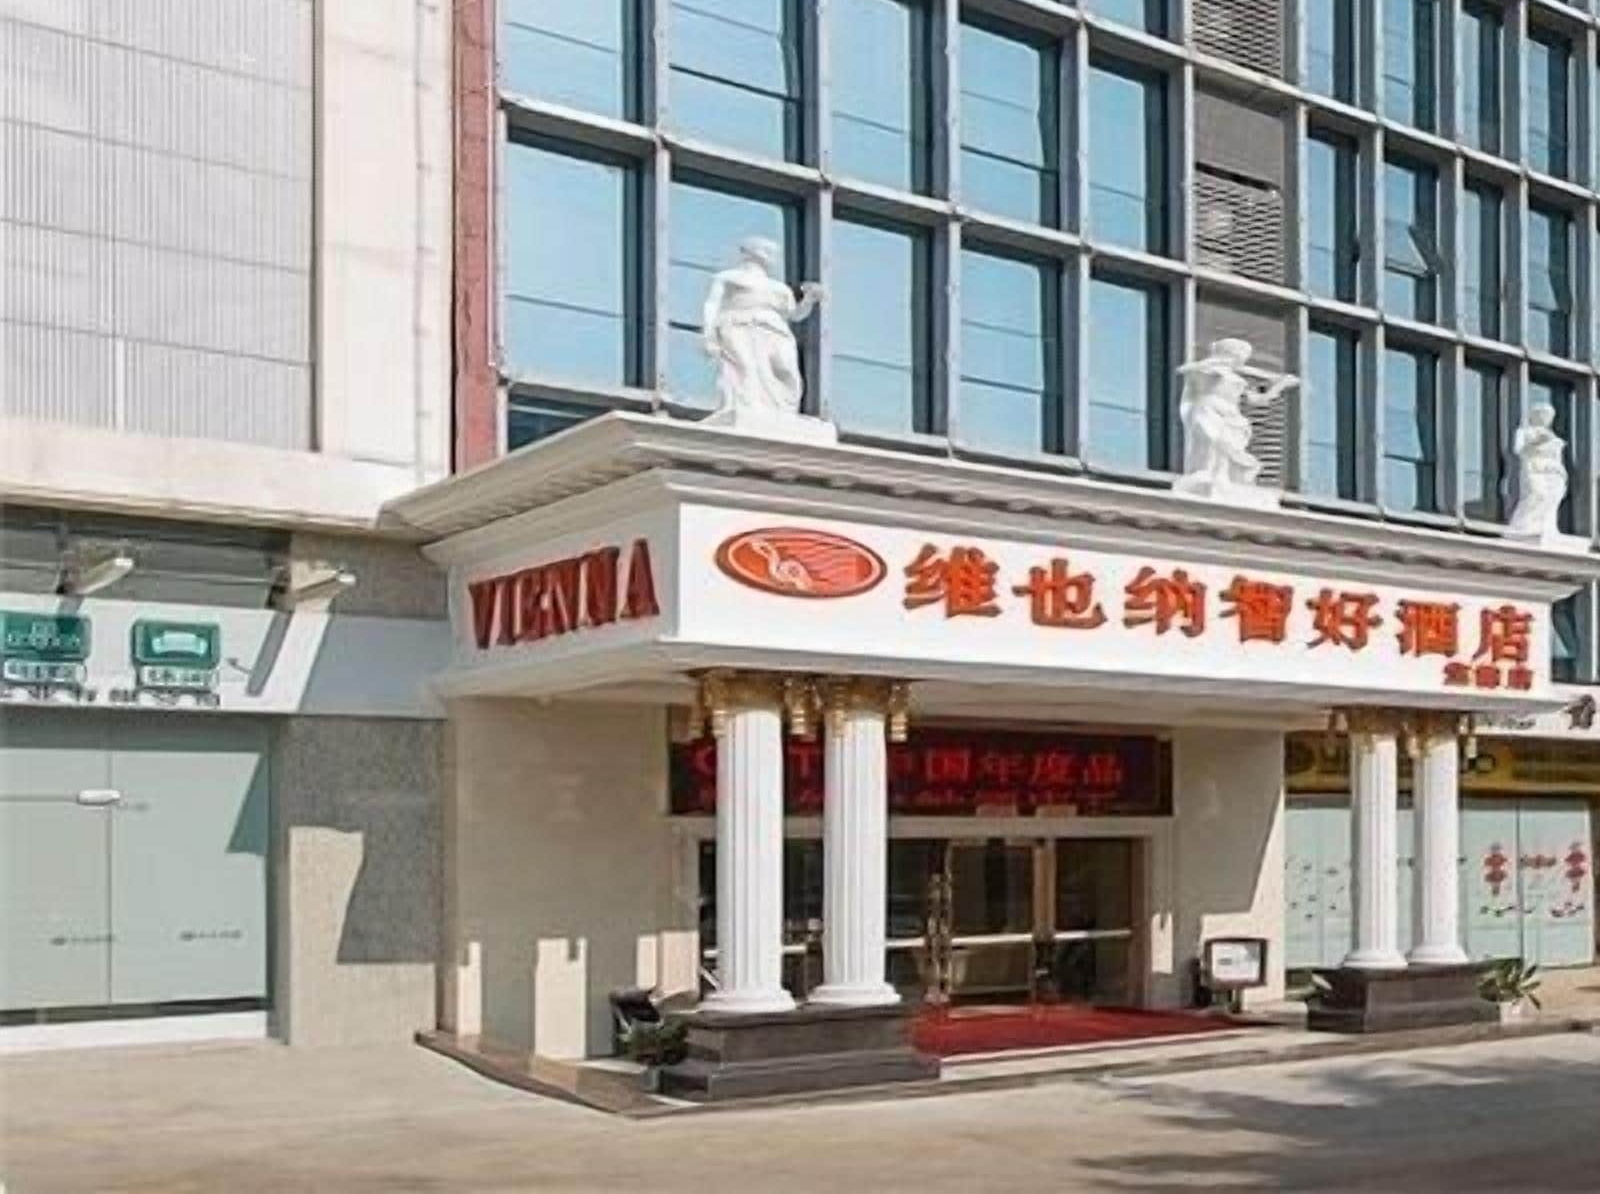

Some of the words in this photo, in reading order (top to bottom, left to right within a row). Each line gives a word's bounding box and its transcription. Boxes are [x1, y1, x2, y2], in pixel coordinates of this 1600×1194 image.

[468, 538, 660, 650] VIENNA
[903, 543, 1535, 663] 维也纳智好酒店
